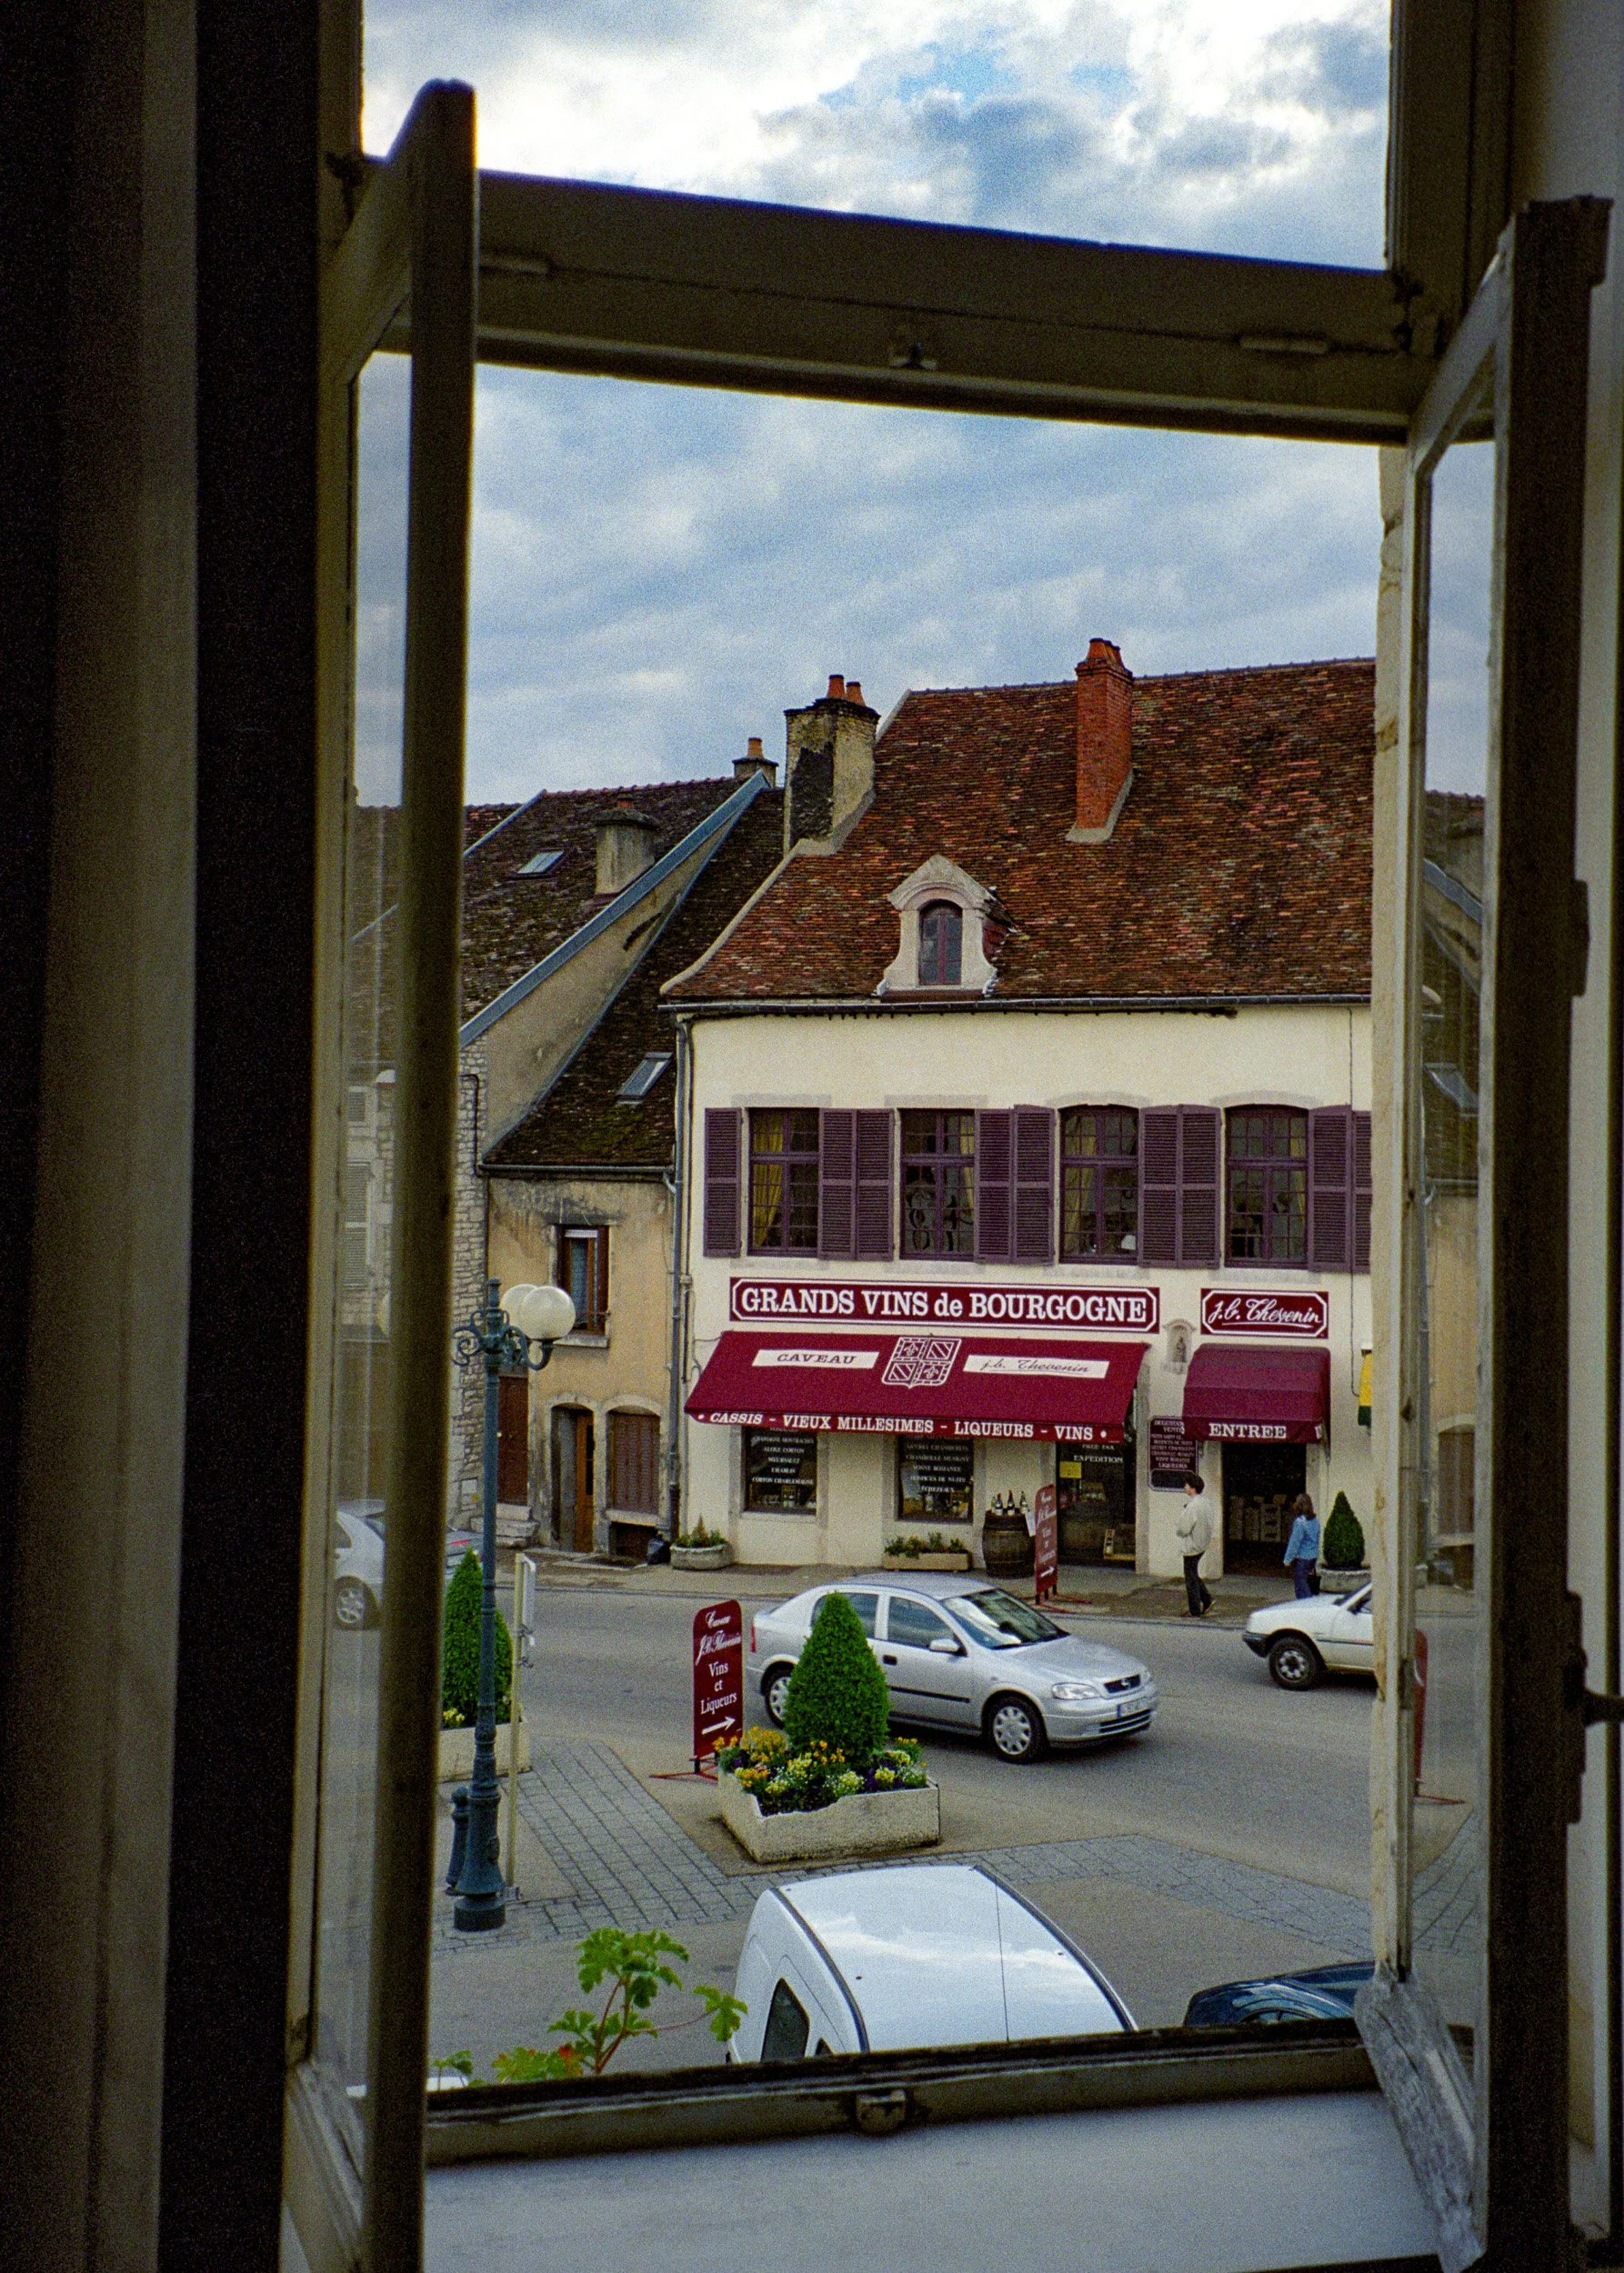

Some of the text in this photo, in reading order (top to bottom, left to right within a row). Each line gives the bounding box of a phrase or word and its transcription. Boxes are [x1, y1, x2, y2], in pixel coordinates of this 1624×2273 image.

[742, 1287, 1148, 1323] GRANDS VINS de BOURGOGNE
[777, 1353, 857, 1365] CAVEAU
[709, 1412, 1093, 1441] CASSIS VIEUX MILLESIMES LIQUEURS VINS
[1208, 1423, 1287, 1439] ENTREE
[1074, 1456, 1123, 1464] EXPEDITION
[708, 1660, 729, 1677] Vins
[714, 1679, 724, 1692] et
[700, 1692, 737, 1715] Liqueurs
